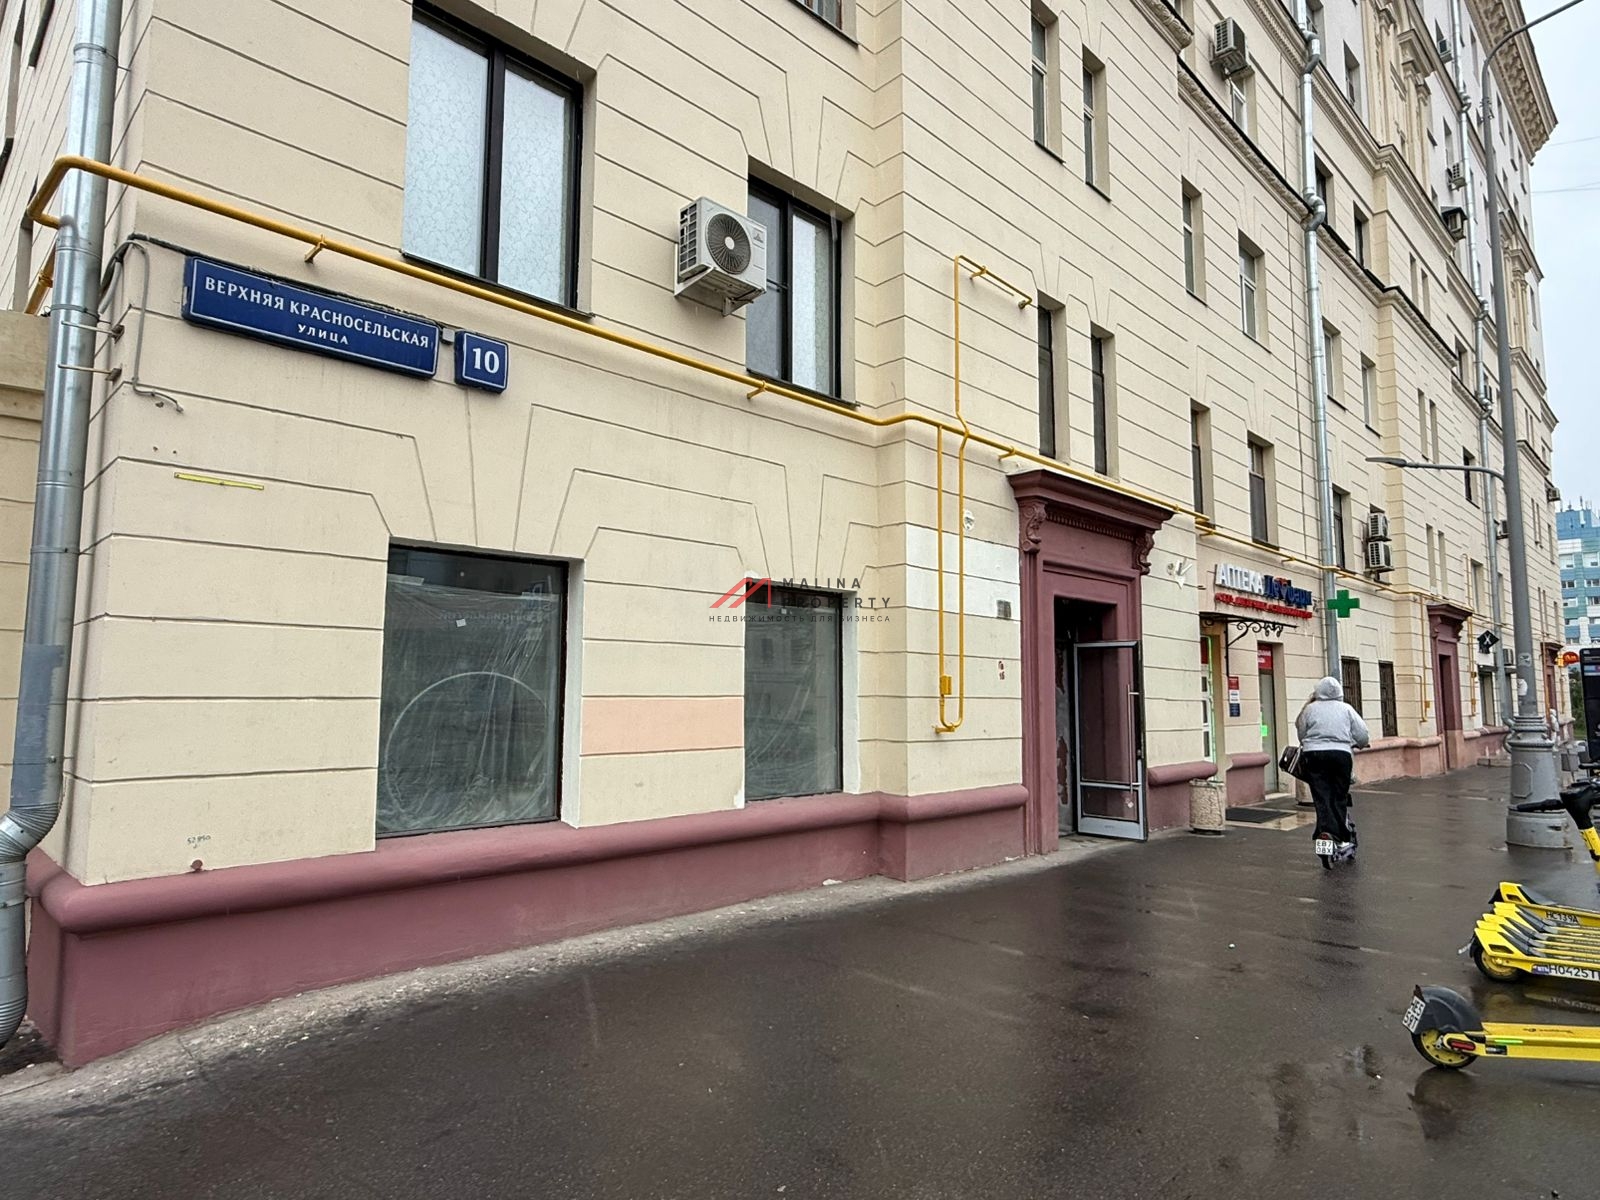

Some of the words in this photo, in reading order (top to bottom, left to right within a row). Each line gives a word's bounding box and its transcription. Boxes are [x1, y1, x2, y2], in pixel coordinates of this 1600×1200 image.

[205, 276, 284, 311] ВЕРХНЯЯ
[290, 300, 429, 348] КРАСНОСЕЛЬСКАЯ
[298, 323, 349, 345] УЛИЦА
[471, 347, 500, 374] 10
[1219, 563, 1264, 594] АПТЕКА
